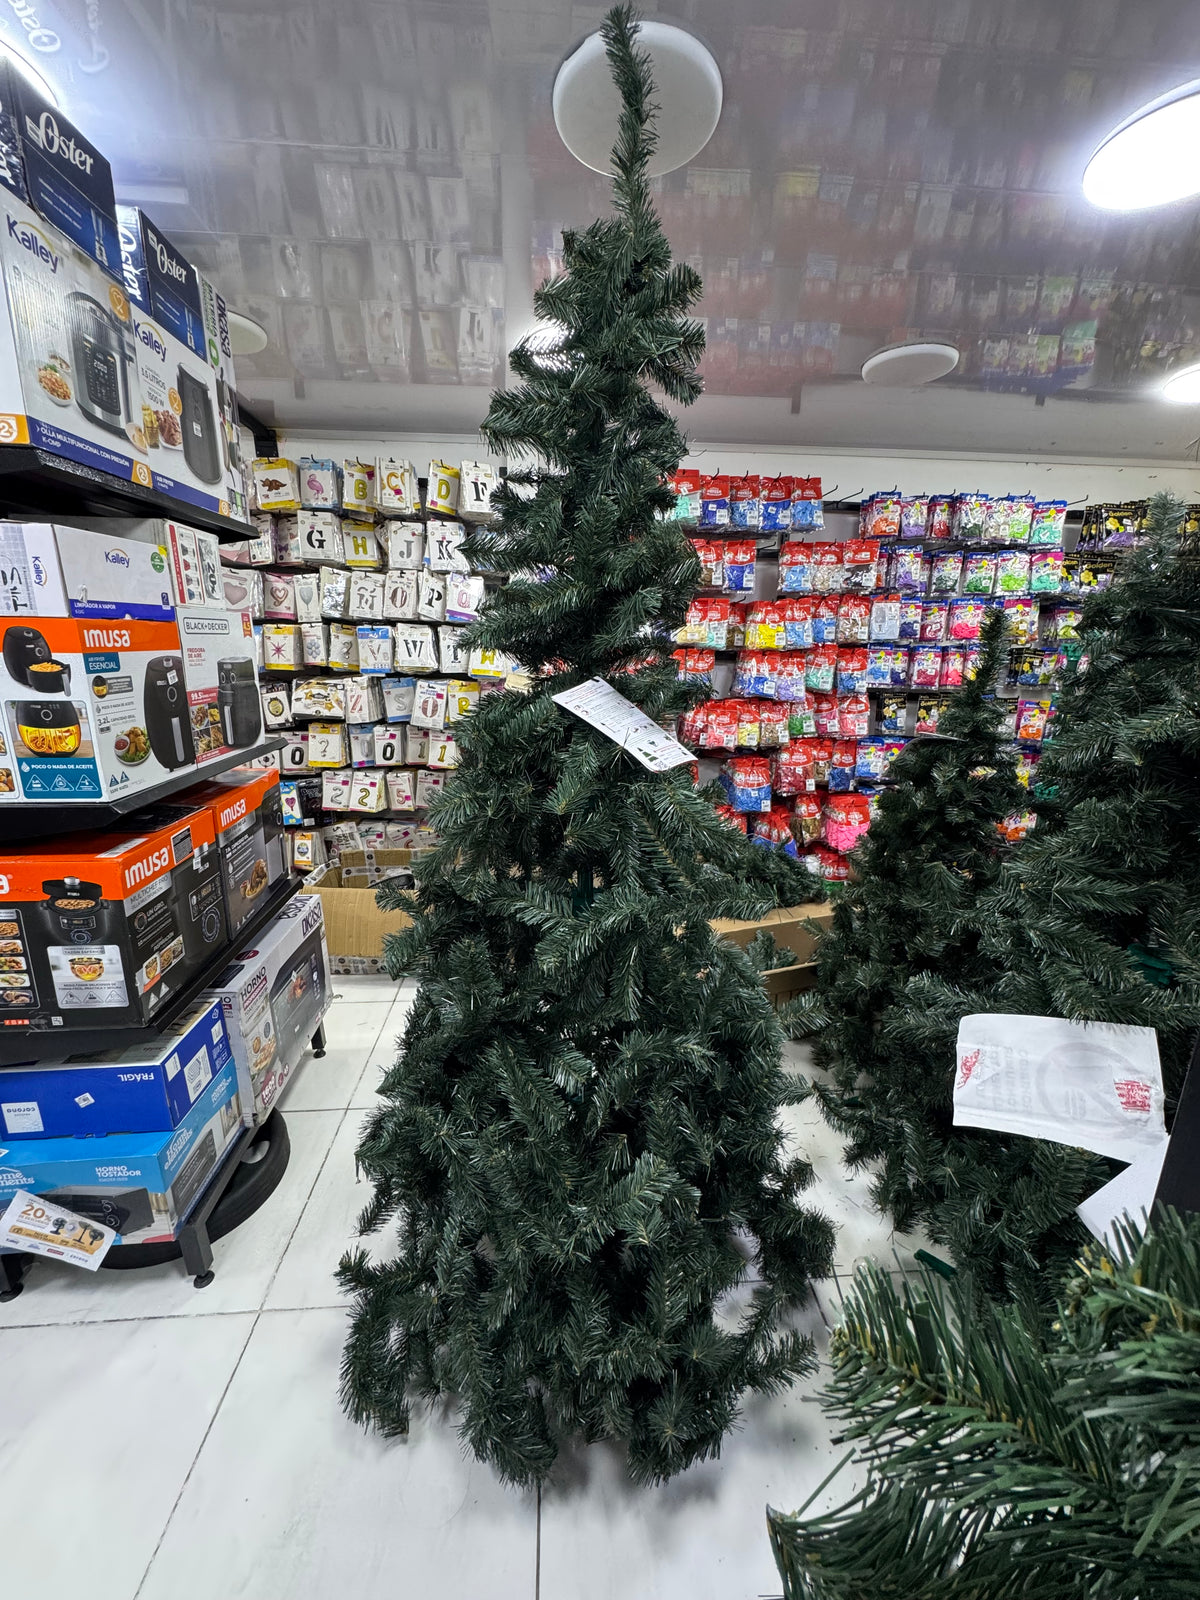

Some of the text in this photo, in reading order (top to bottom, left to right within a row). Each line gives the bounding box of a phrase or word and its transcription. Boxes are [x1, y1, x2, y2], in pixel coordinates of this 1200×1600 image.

[39, 112, 94, 175] Oster
[6, 214, 58, 274] Kalley
[157, 244, 187, 284] Oster
[133, 319, 167, 362] Kalley
[40, 427, 130, 467] OLLA MULTIFUNCIONAL CON PRESIÓN
[354, 479, 368, 501] B
[386, 472, 399, 491] C
[438, 479, 451, 501] D
[473, 481, 488, 502] F
[306, 529, 326, 549] G
[352, 535, 368, 555] H
[398, 539, 414, 559] J
[436, 539, 454, 560] K
[104, 551, 130, 568] Kalley
[1085, 561, 1113, 569] Golden
[32, 556, 44, 586] Kalley
[356, 587, 377, 611] Ñ
[425, 588, 443, 607] P
[185, 621, 228, 632] BLACK+DECKER
[404, 639, 425, 658] W
[89, 662, 118, 671] ESENCIAL
[350, 694, 363, 714] Z
[394, 694, 408, 711] S
[438, 745, 447, 763] 1
[330, 787, 344, 805] 2
[358, 788, 371, 806] 2
[397, 789, 406, 805] 5
[240, 966, 266, 1001] HORNO
[117, 1072, 155, 1083] FRÁGIL
[0, 1171, 24, 1179] ome
[97, 1169, 141, 1178] TOSTADOR
[21, 1204, 53, 1222] 20%
